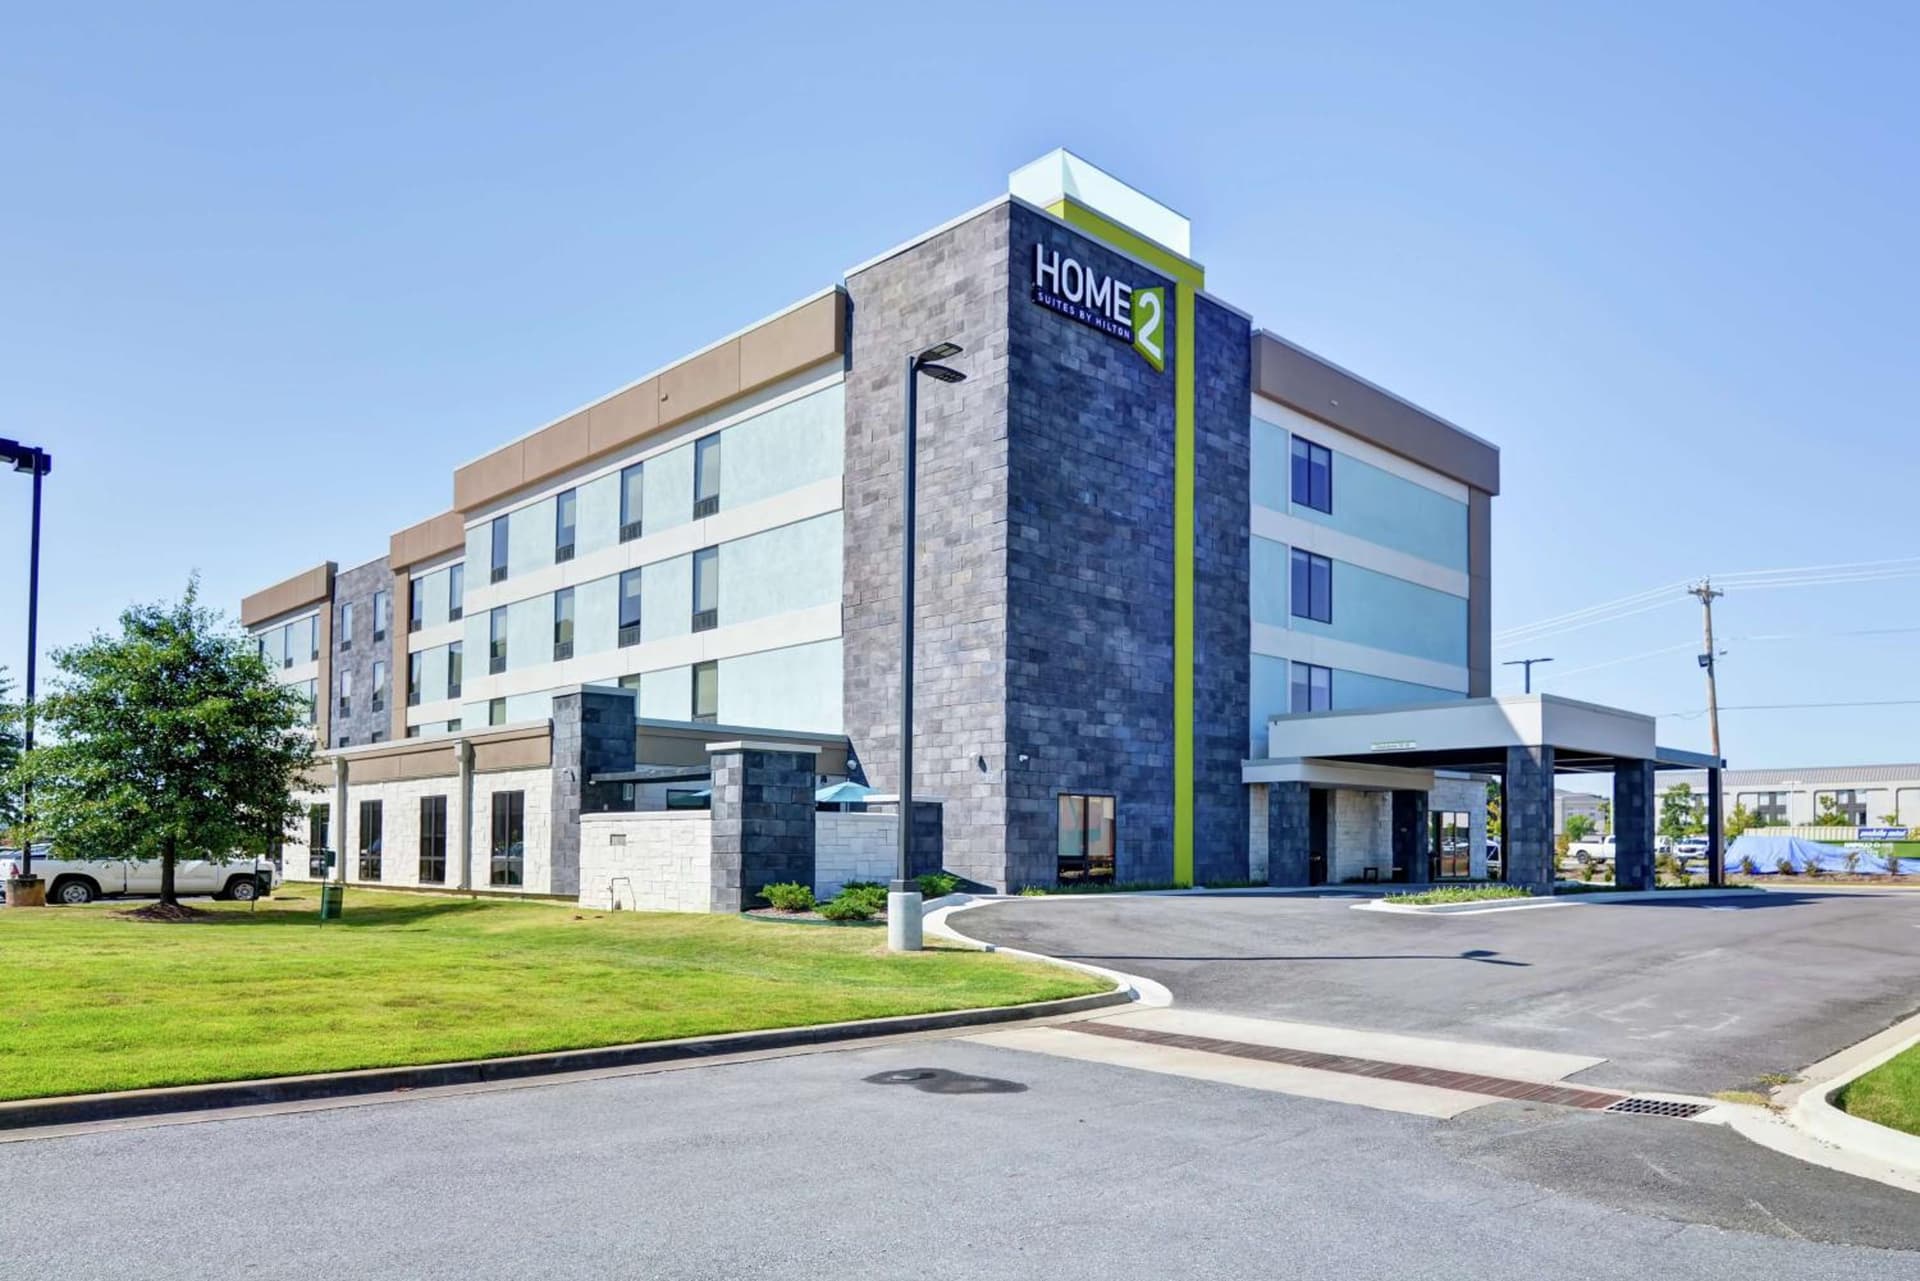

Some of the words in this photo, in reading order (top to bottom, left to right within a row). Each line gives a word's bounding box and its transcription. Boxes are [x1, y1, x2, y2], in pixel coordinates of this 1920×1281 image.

[1036, 243, 1132, 327] HOME
[1138, 292, 1161, 360] 2
[1038, 292, 1075, 315] SUITES
[1080, 308, 1092, 322] BY
[1096, 317, 1131, 339] HILTON
